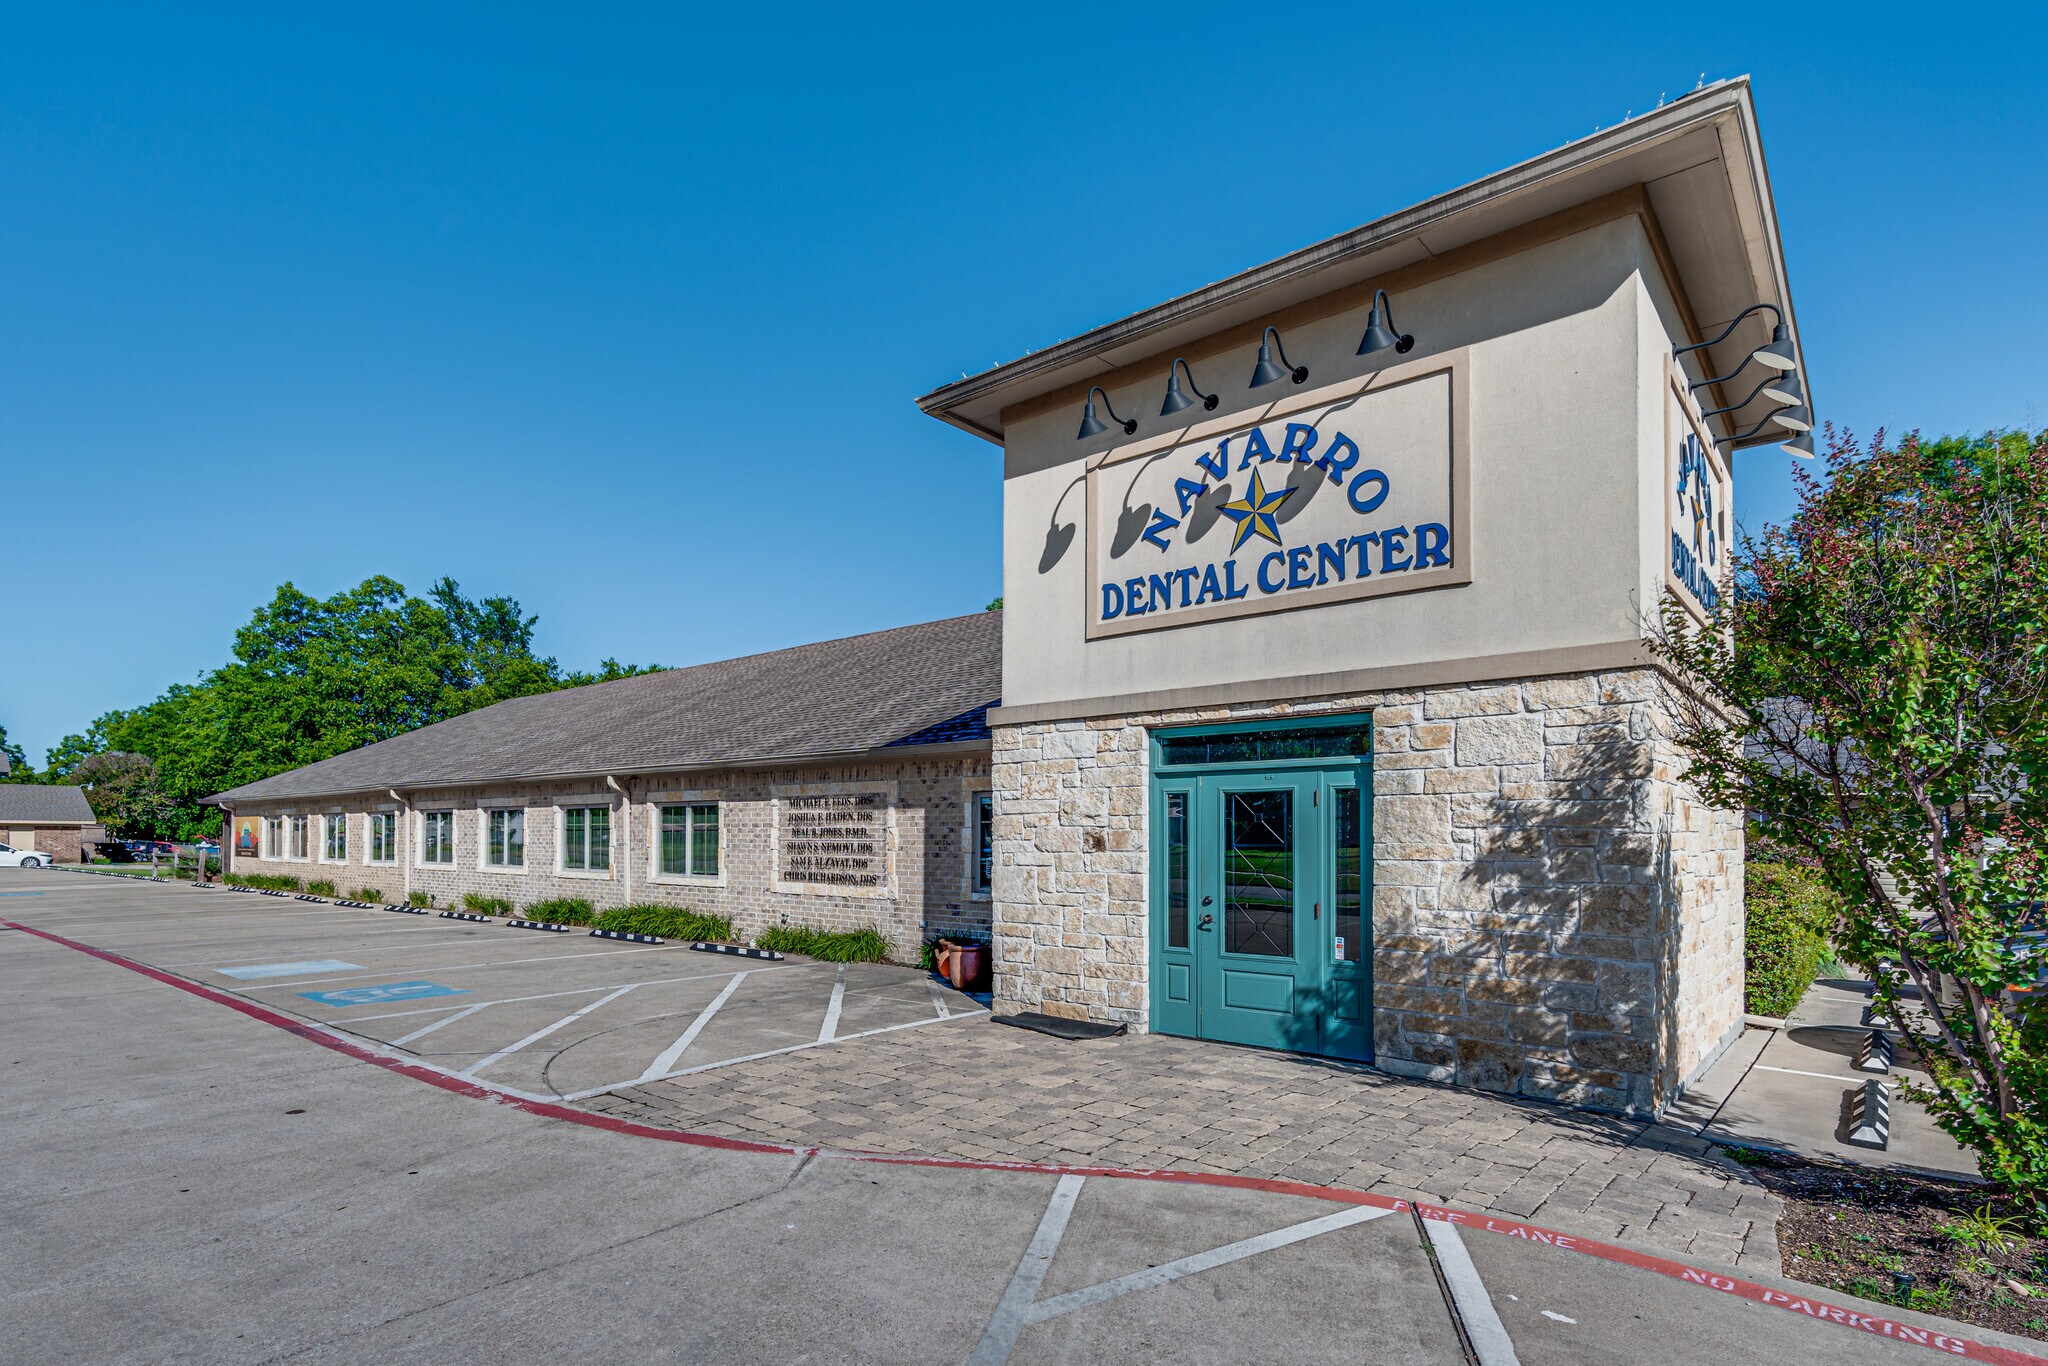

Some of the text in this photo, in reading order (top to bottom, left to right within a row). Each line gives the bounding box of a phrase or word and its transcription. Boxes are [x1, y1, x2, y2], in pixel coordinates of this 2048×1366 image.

[1141, 422, 1390, 553] NAVARRO
[1101, 522, 1450, 620] DENTAL CENTER
[789, 798, 823, 808] MICHAEL
[854, 796, 872, 805] DDS
[788, 813, 816, 823] JOSHUA
[857, 812, 873, 823] DDS
[792, 828, 810, 837] NEAL
[787, 842, 813, 851] SHAWN
[857, 843, 873, 853] DDS
[791, 857, 807, 866] SAM
[852, 858, 869, 869] DDS
[784, 871, 807, 881] CHRIS
[860, 874, 877, 885] DDS
[1487, 1220, 1577, 1250] LANE
[1682, 1268, 1966, 1355] NO PARKING
